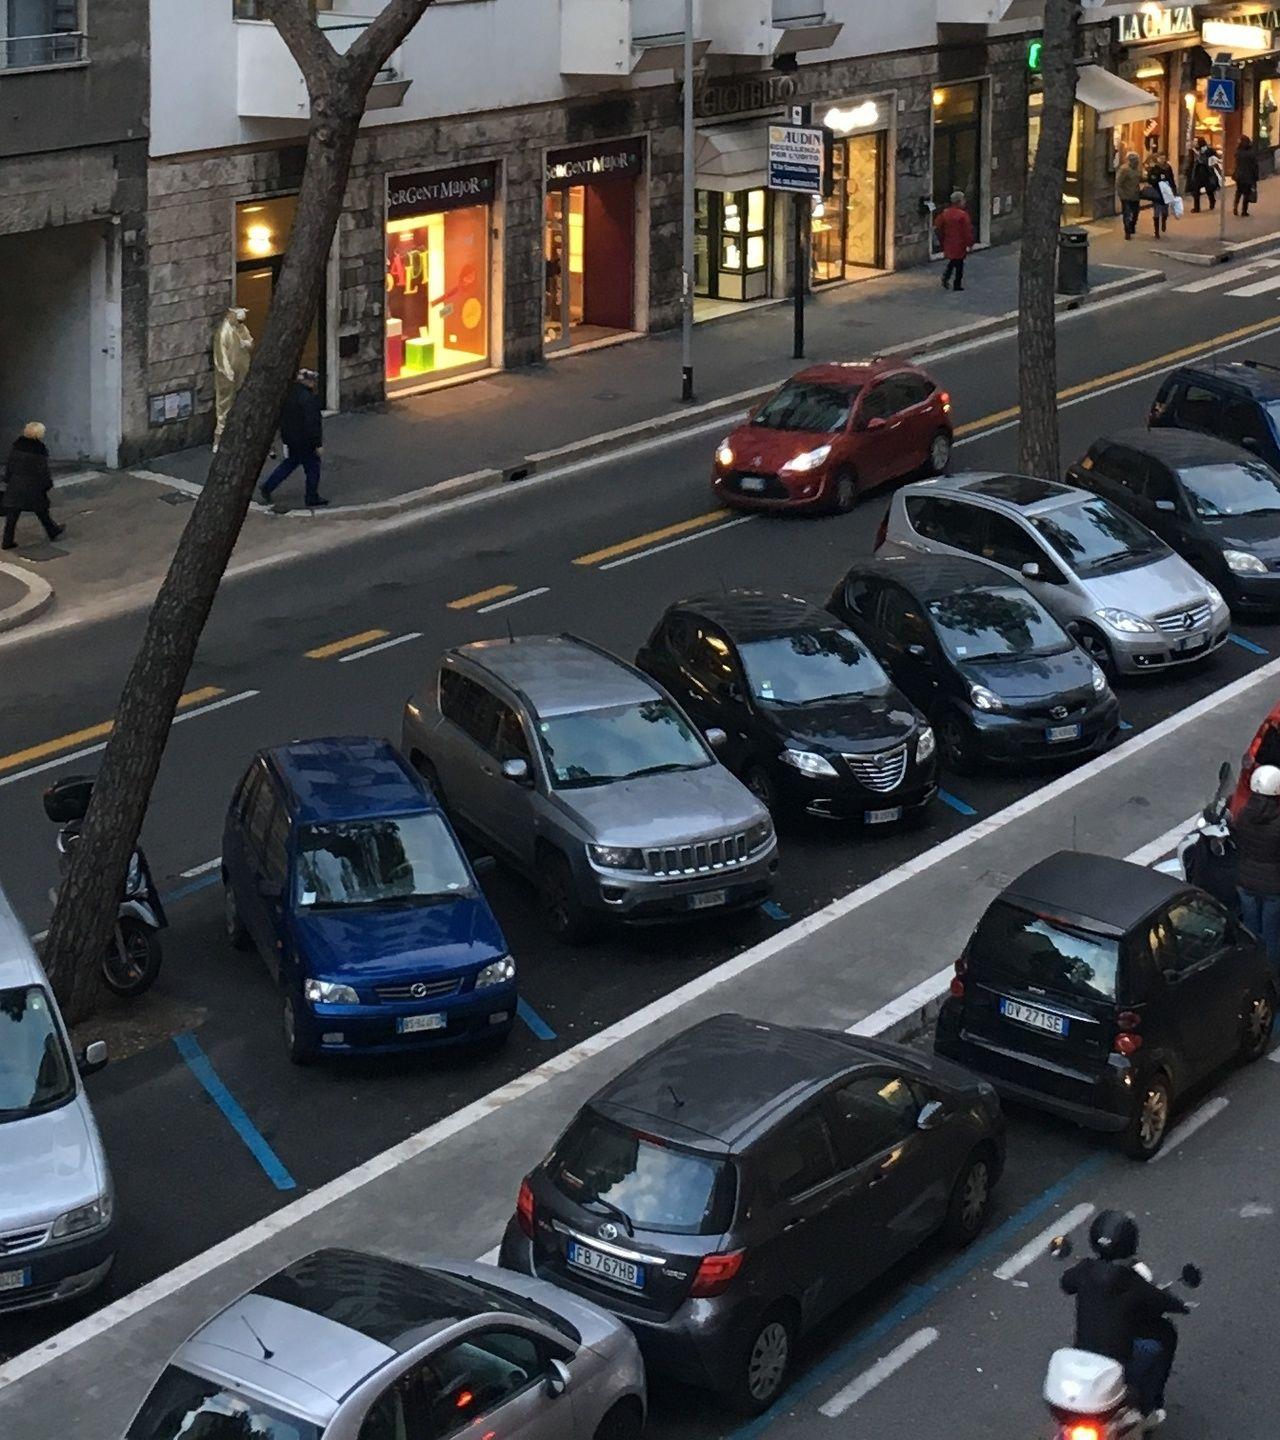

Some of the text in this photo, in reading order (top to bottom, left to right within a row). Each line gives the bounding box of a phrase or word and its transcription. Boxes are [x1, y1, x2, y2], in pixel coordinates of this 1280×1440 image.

[1118, 13, 1141, 42] LA
[784, 131, 821, 145] AUDIN
[1024, 1008, 1061, 1032] 271SE
[575, 1247, 592, 1264] FB
[595, 1254, 635, 1281] 767HB
